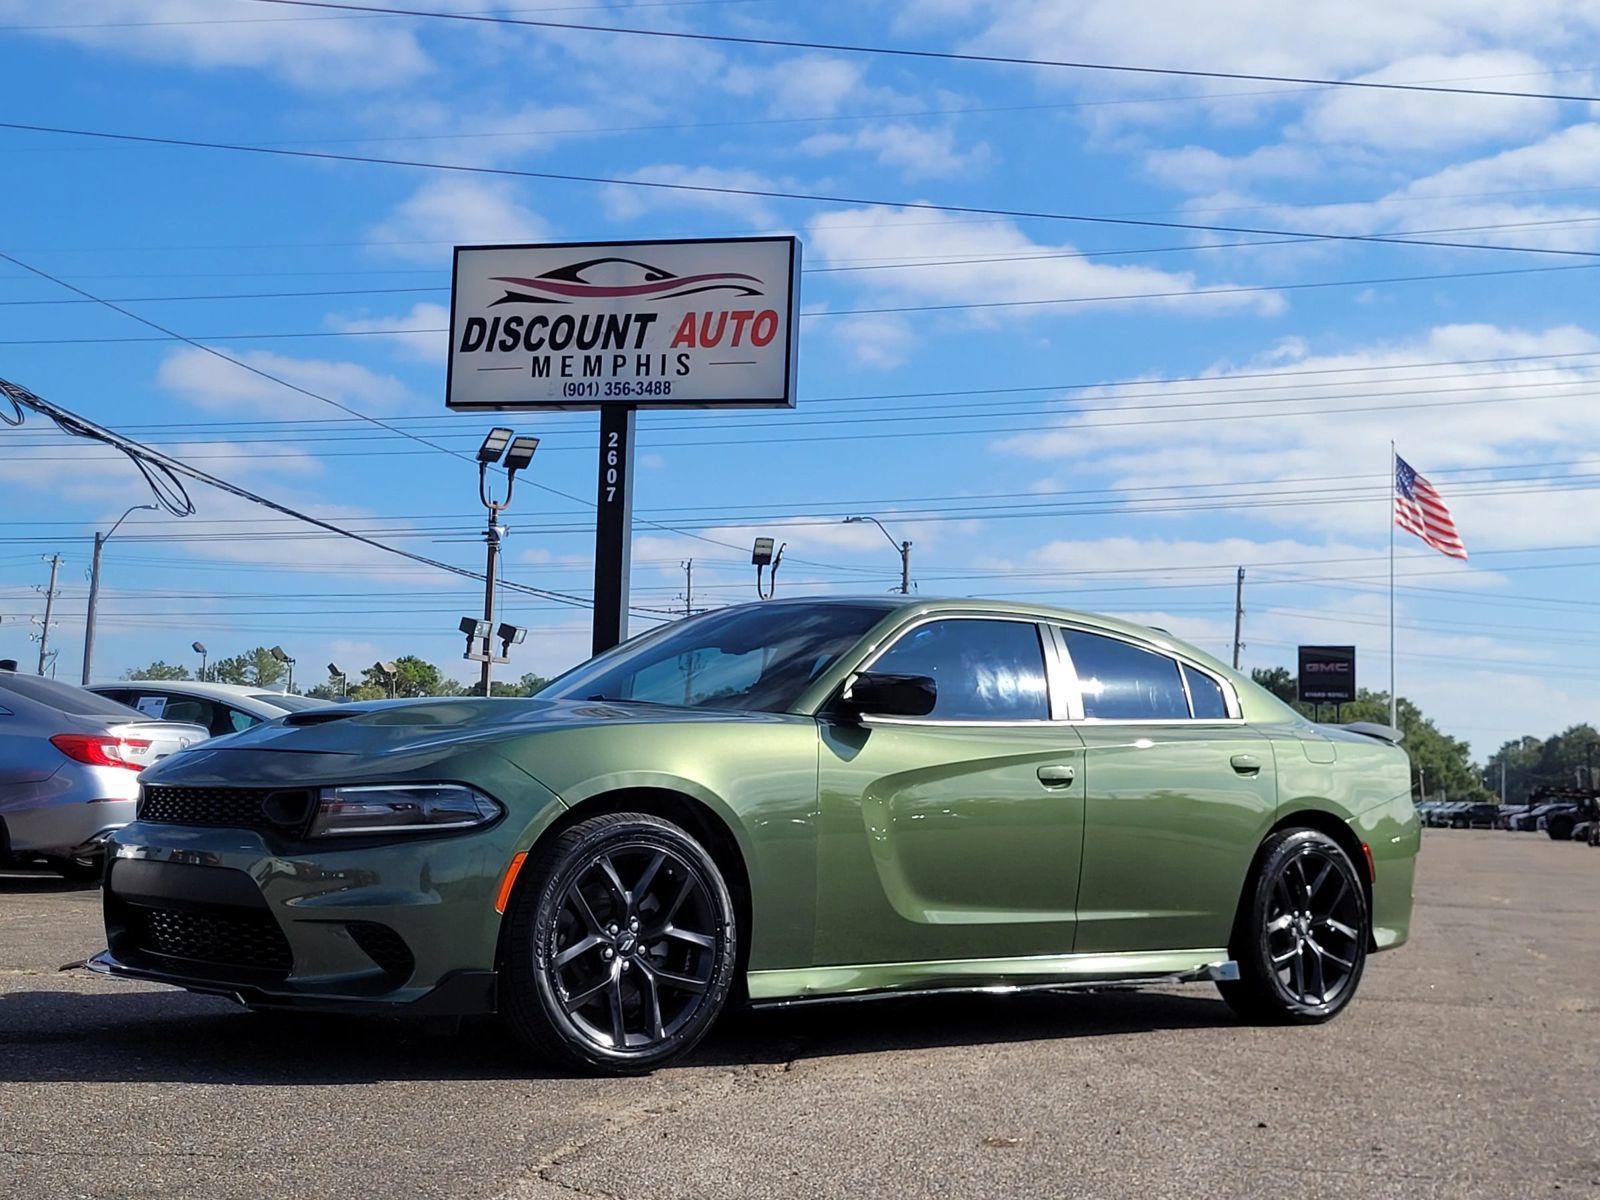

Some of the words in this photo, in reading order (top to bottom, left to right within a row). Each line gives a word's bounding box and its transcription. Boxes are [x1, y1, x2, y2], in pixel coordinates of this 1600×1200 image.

[459, 313, 658, 353] DISCOUNT
[670, 309, 780, 349] AUTO
[531, 353, 691, 378] MEMPHIS
[562, 381, 600, 398] (901)
[604, 380, 672, 397] 356-3488
[606, 432, 619, 502] 2607
[1305, 663, 1349, 672] GMC
